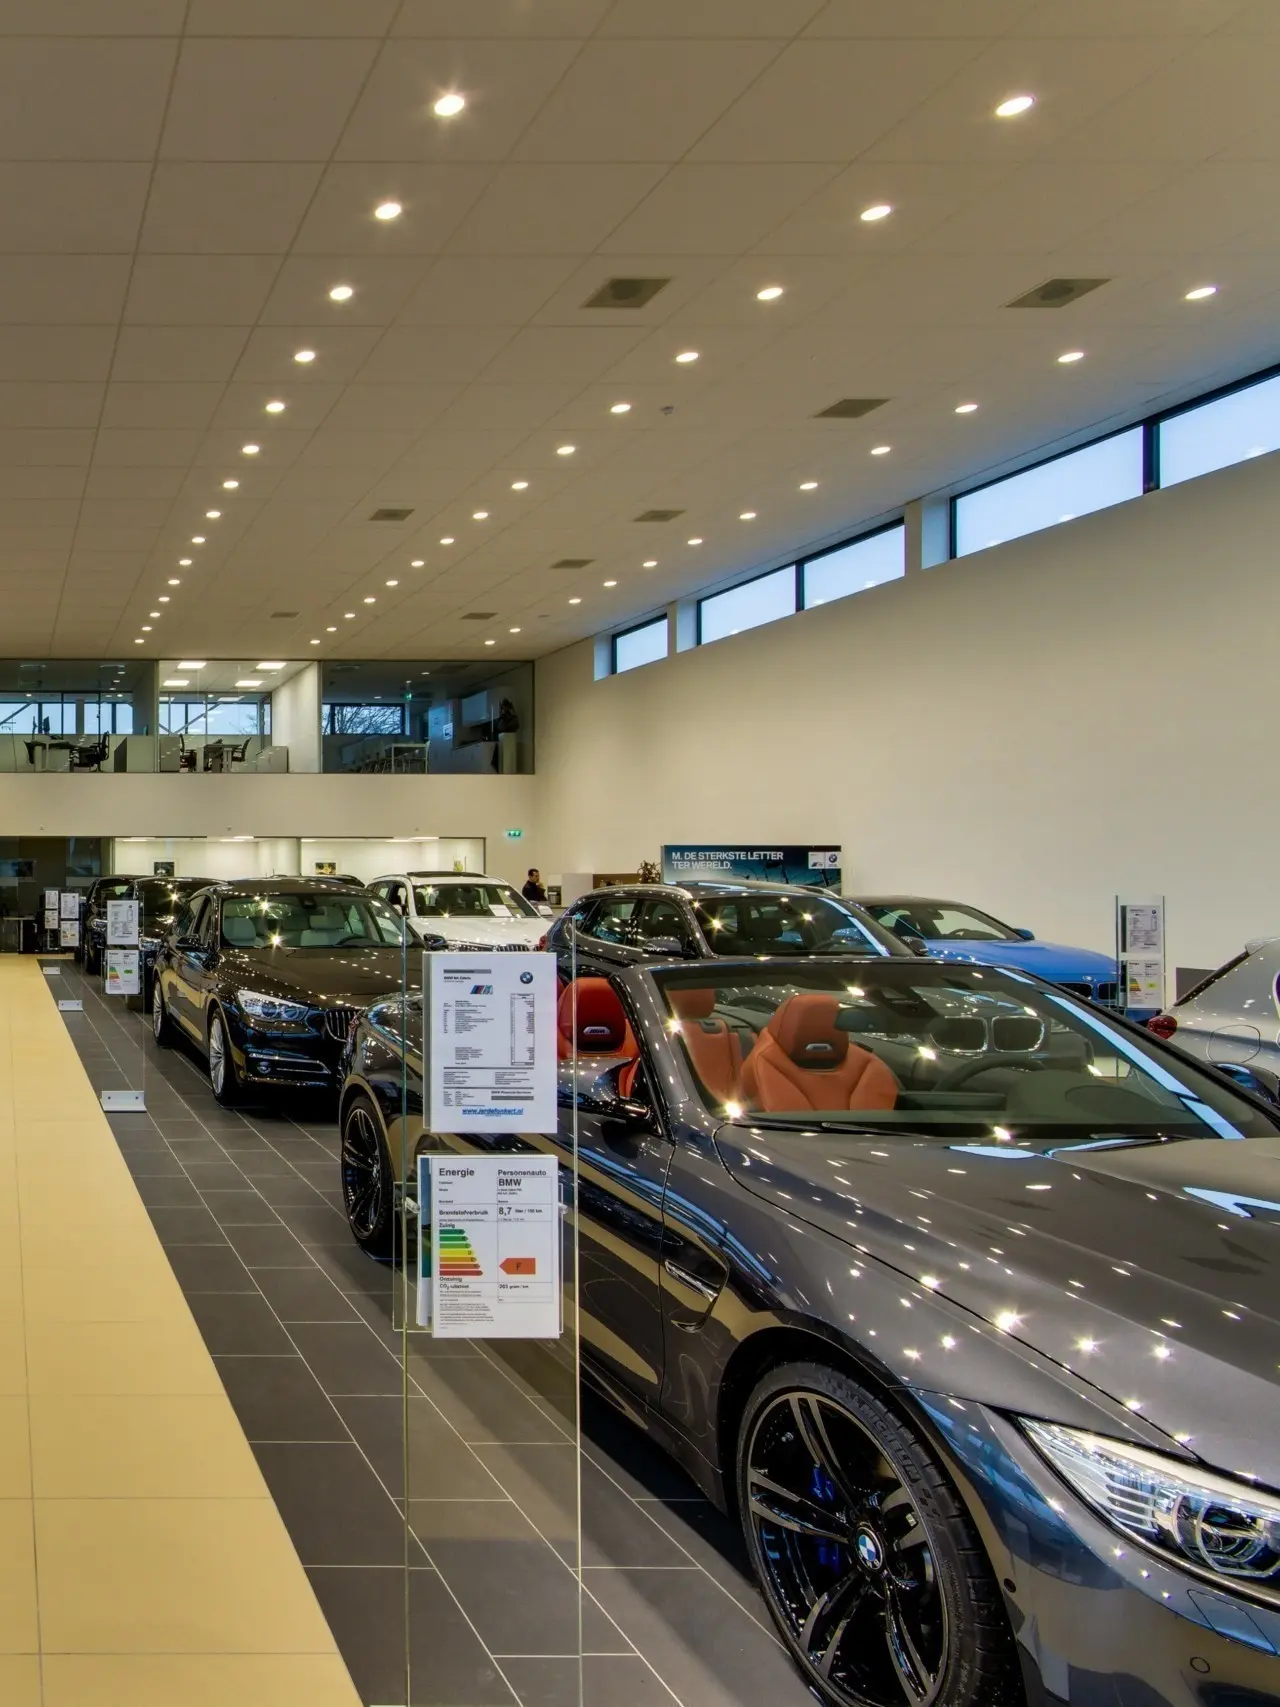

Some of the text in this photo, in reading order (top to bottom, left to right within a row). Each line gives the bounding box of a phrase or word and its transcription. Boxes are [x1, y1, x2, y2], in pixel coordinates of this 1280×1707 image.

[672, 852, 784, 860] M. DE STERKSTE LETTER
[672, 861, 732, 870] TER WERELD.
[439, 1167, 475, 1178] Energie
[499, 1178, 522, 1187] BMW
[499, 1207, 512, 1216] 8,7
